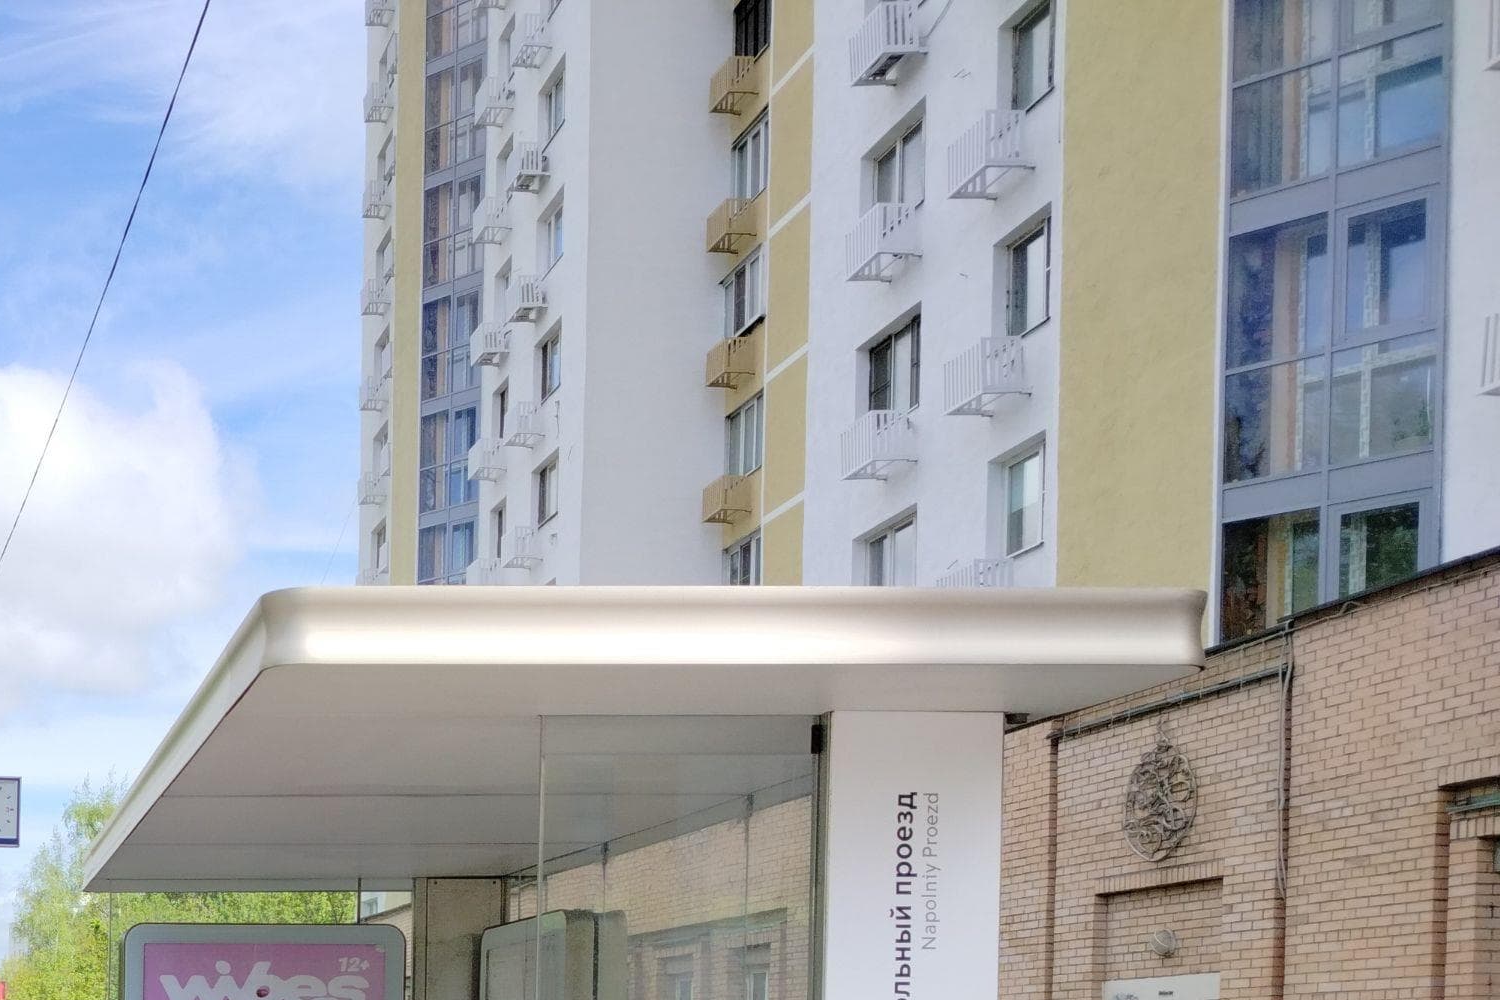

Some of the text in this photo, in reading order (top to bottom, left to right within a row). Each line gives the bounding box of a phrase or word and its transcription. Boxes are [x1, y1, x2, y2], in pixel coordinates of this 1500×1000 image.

[895, 791, 917, 895] проезд
[922, 791, 941, 951] Napolniy Proezd
[339, 957, 370, 971] 12+
